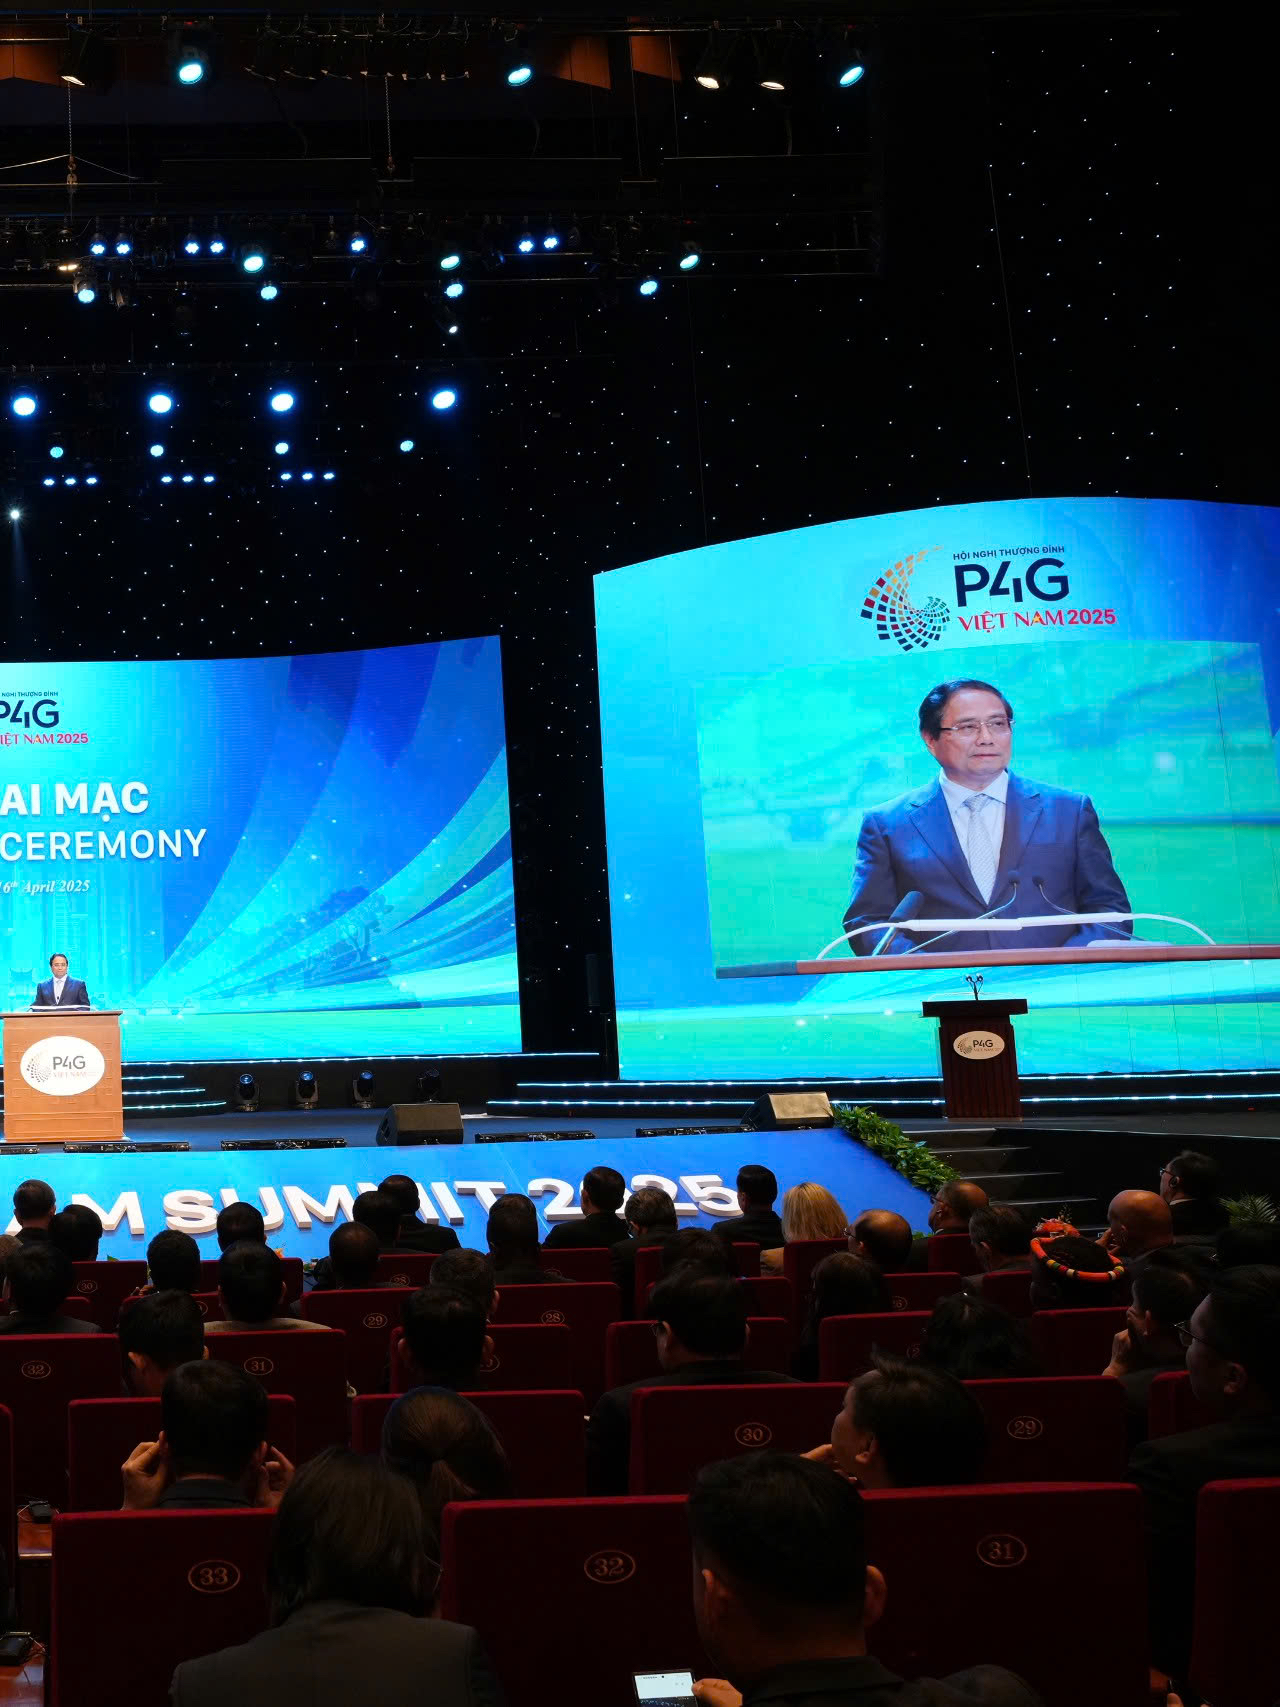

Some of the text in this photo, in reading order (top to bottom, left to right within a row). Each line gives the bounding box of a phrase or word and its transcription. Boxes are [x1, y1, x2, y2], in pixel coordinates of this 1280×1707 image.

[954, 557, 1069, 607] P4G
[957, 608, 1117, 633] VIỆT NAM 2025
[24, 733, 55, 745] NAM
[56, 733, 89, 744] 2025
[55, 781, 149, 823] MẠC
[0, 828, 207, 862] CEREMONY
[23, 881, 56, 896] April
[59, 880, 91, 893] 2025
[973, 1039, 993, 1048] P4G
[53, 1055, 85, 1070] P4G
[528, 1174, 745, 1221] 225
[368, 1316, 383, 1325] 29
[546, 1313, 560, 1323] 28
[27, 1364, 44, 1375] 32
[251, 1361, 265, 1371] 31
[743, 1428, 763, 1441] 30
[1014, 1420, 1036, 1434] 29
[989, 1541, 1014, 1559] 31
[594, 1557, 624, 1577] 32
[200, 1567, 228, 1585] 33
